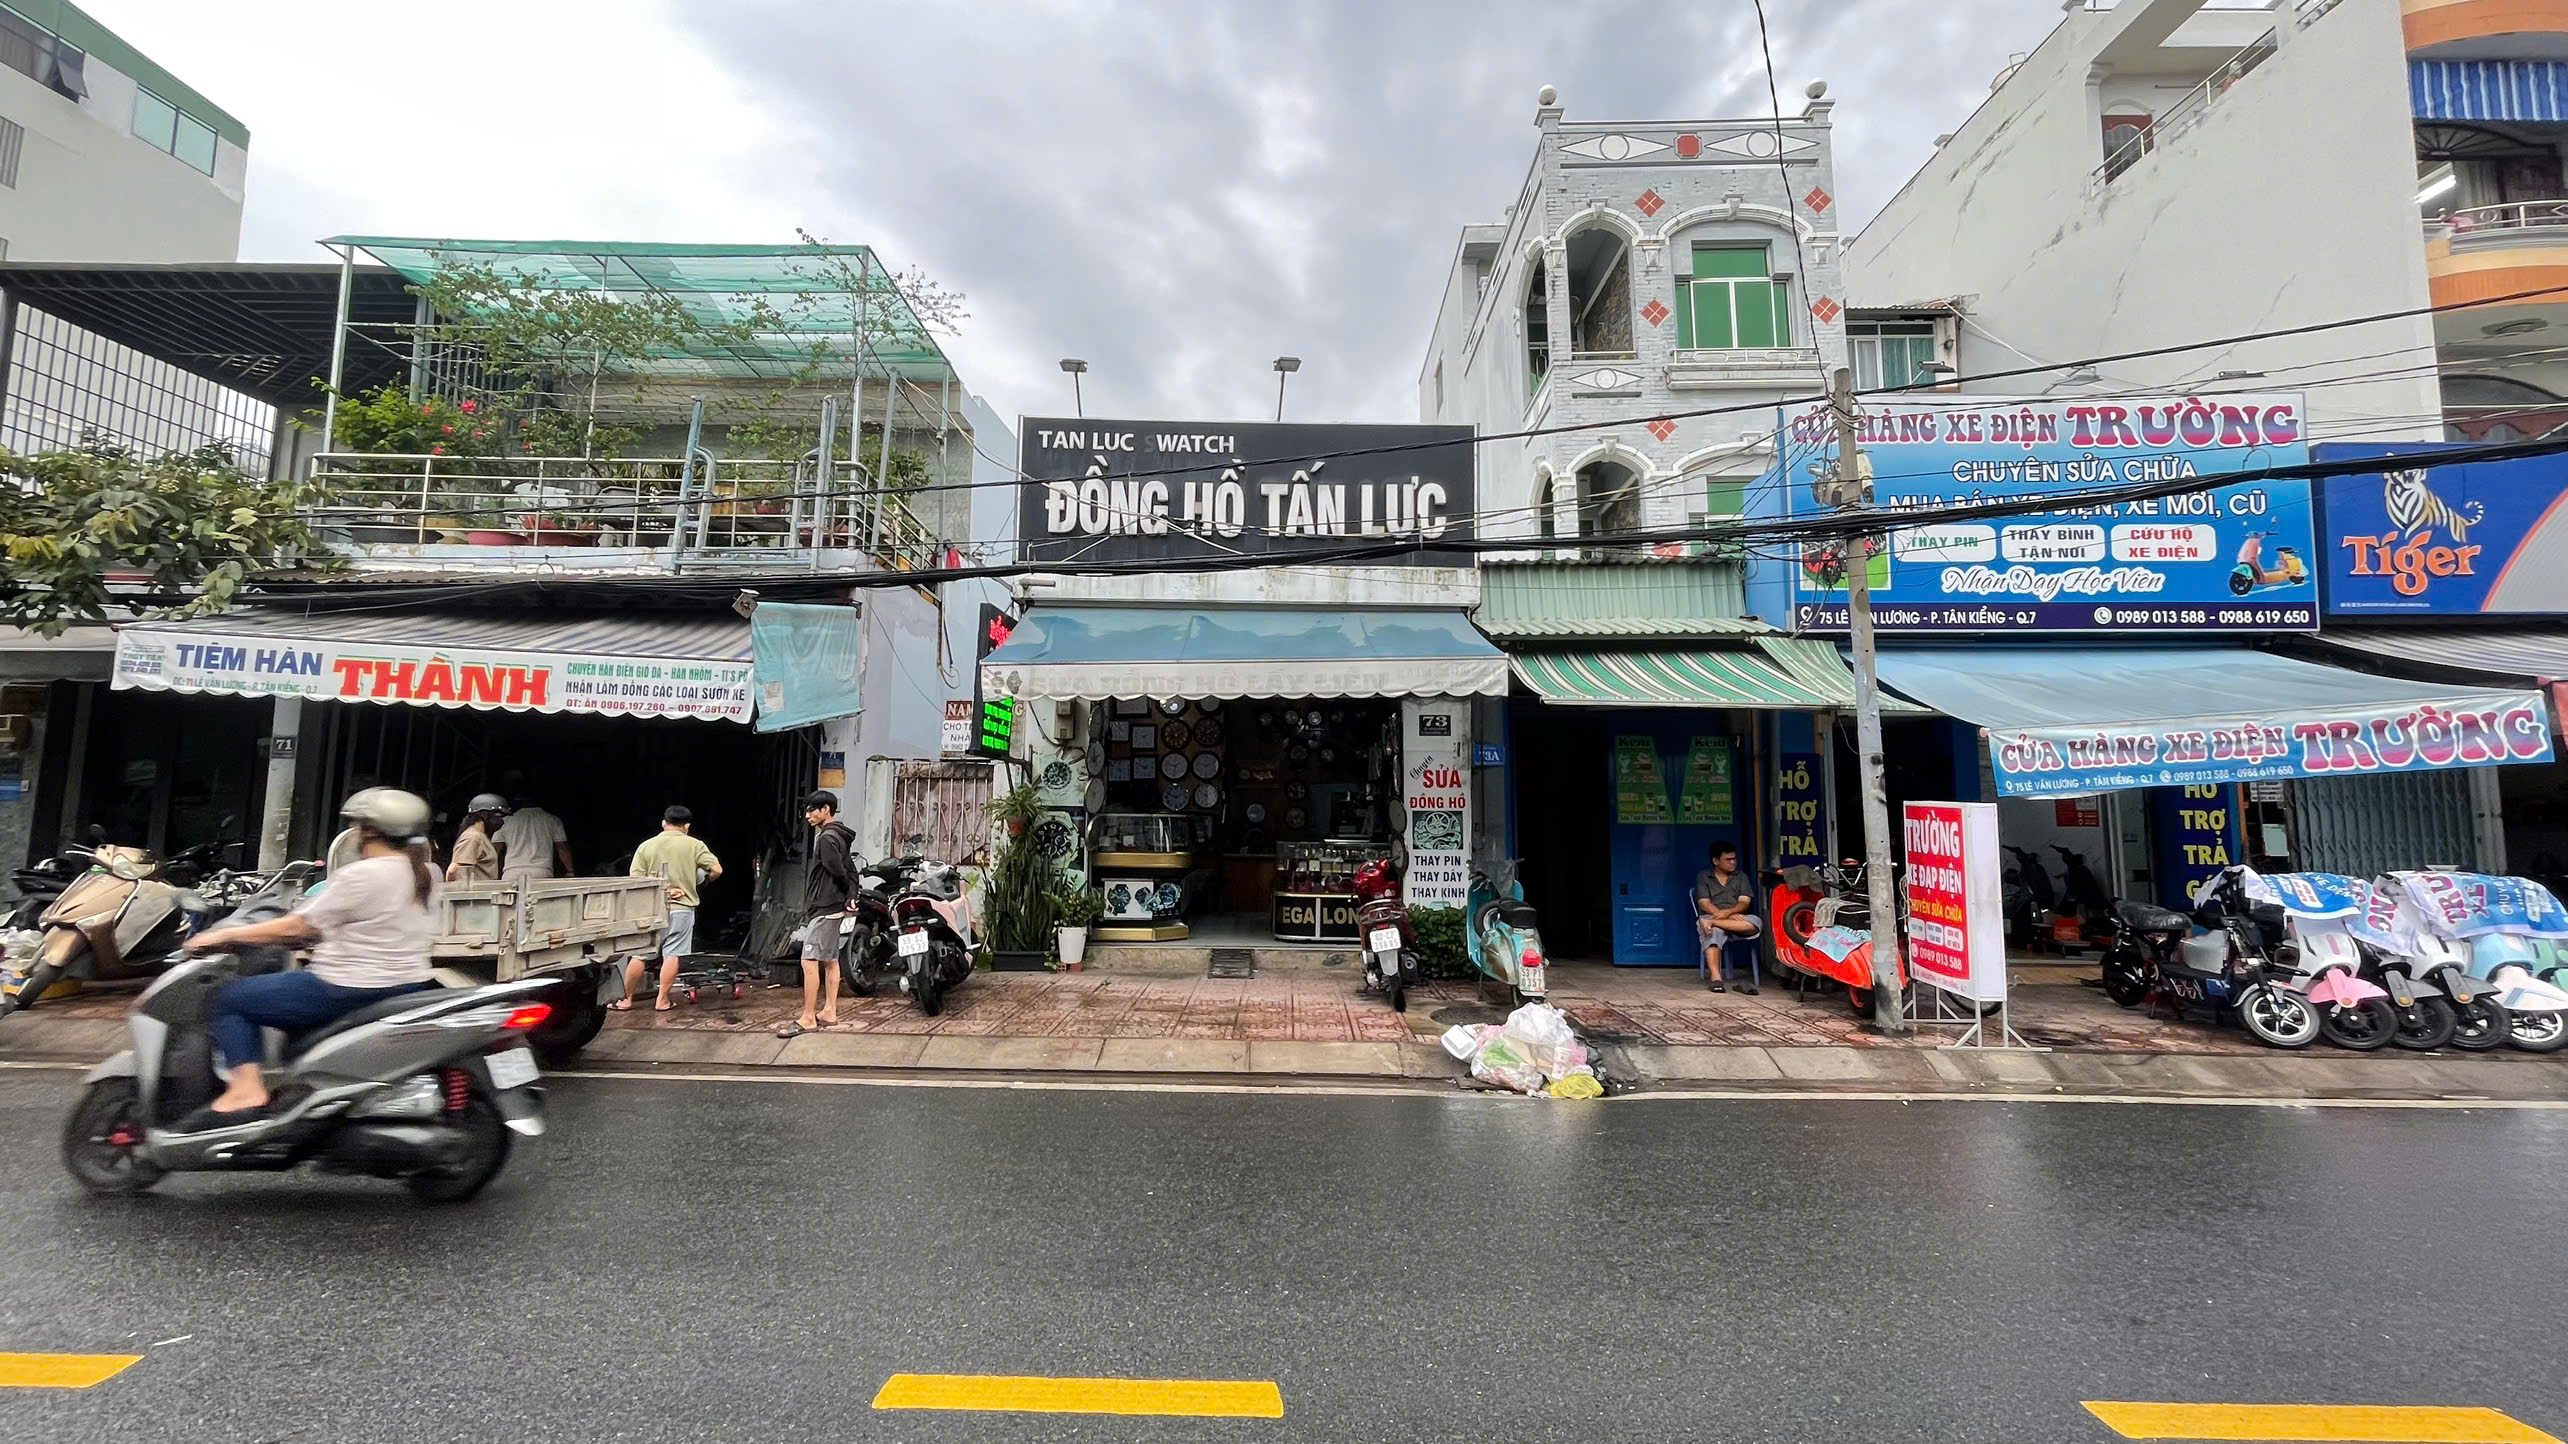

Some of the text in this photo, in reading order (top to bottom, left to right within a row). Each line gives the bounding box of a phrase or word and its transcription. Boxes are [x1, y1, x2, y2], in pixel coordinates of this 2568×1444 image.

[1856, 407, 1937, 443] HÀNG
[1945, 413, 1983, 443] XE
[1990, 406, 2057, 449] ĐIỆN
[2065, 396, 2299, 447] TRƯỜNG
[1038, 430, 1085, 450] TAN
[1092, 431, 1134, 452] LUC
[1952, 453, 2197, 483] CHUYÊN SỬA CHỮA
[1044, 455, 1448, 544] ĐỒNG HỒ TẤN LỰC
[2125, 494, 2160, 515] XE
[2165, 491, 2222, 519] MỚI,
[2228, 488, 2267, 515] CŨ
[1910, 535, 1979, 548] THAY PIN
[2008, 528, 2095, 541] THAY BÌNH
[2130, 528, 2193, 543] CỨU HỘ
[2020, 546, 2054, 560] TẬN
[2128, 546, 2199, 560] XE ĐIỆN
[2341, 530, 2482, 596] Tiger
[1944, 568, 2164, 599] Nhận Dạy Học Viên
[1819, 611, 1833, 625] 75
[1835, 609, 1849, 625] LÊ
[1880, 611, 1920, 625] LƯƠNG
[1931, 612, 1941, 625] P.
[1943, 609, 1967, 625] TÂN
[1969, 605, 2006, 625] KIỂNG
[2016, 611, 2037, 625] Q.7
[2116, 610, 2309, 624] 0989 013 588 0988 619 650
[176, 641, 551, 706] TIỆM HÀN THÀNH
[567, 662, 597, 677] CHUYÊN
[566, 681, 593, 697] NHẬN
[596, 680, 618, 695] LÀM
[652, 682, 673, 698] CÁC
[676, 686, 698, 702] LOẠI
[732, 688, 745, 701] XE
[944, 722, 961, 731] CHO
[1422, 716, 1448, 727] 73
[276, 739, 292, 750] 71
[2001, 705, 2548, 771] CỬA HÀNG XE ĐIỆN TRƯỜNG
[1422, 763, 1462, 789] SỬA
[1778, 761, 1810, 790] HỖ
[2173, 772, 2195, 782] 0989
[2196, 770, 2212, 781] 013
[2259, 766, 2276, 776] 619
[2277, 765, 2294, 775] 650
[2015, 783, 2024, 792] 75
[2034, 780, 2051, 790] VĂN
[1409, 792, 1466, 809] ĐỒNG HỒ
[1775, 799, 1818, 827] TRỢ
[2179, 808, 2226, 835] TRỢ
[1779, 828, 1819, 856] TRẢ
[1905, 810, 1961, 859] TRƯỜNG
[2183, 837, 2230, 865] TRẢ
[1414, 855, 1461, 867] THAY PIN
[1413, 868, 1463, 882] THAY DÂY
[1919, 865, 1938, 895] ĐẠP
[1939, 862, 1962, 900] ĐIỆN
[1412, 884, 1465, 898] THAY KÍNH
[1282, 906, 1315, 924] EGA
[1910, 896, 1931, 915] HUYÊN
[1935, 951, 1949, 967] 013
